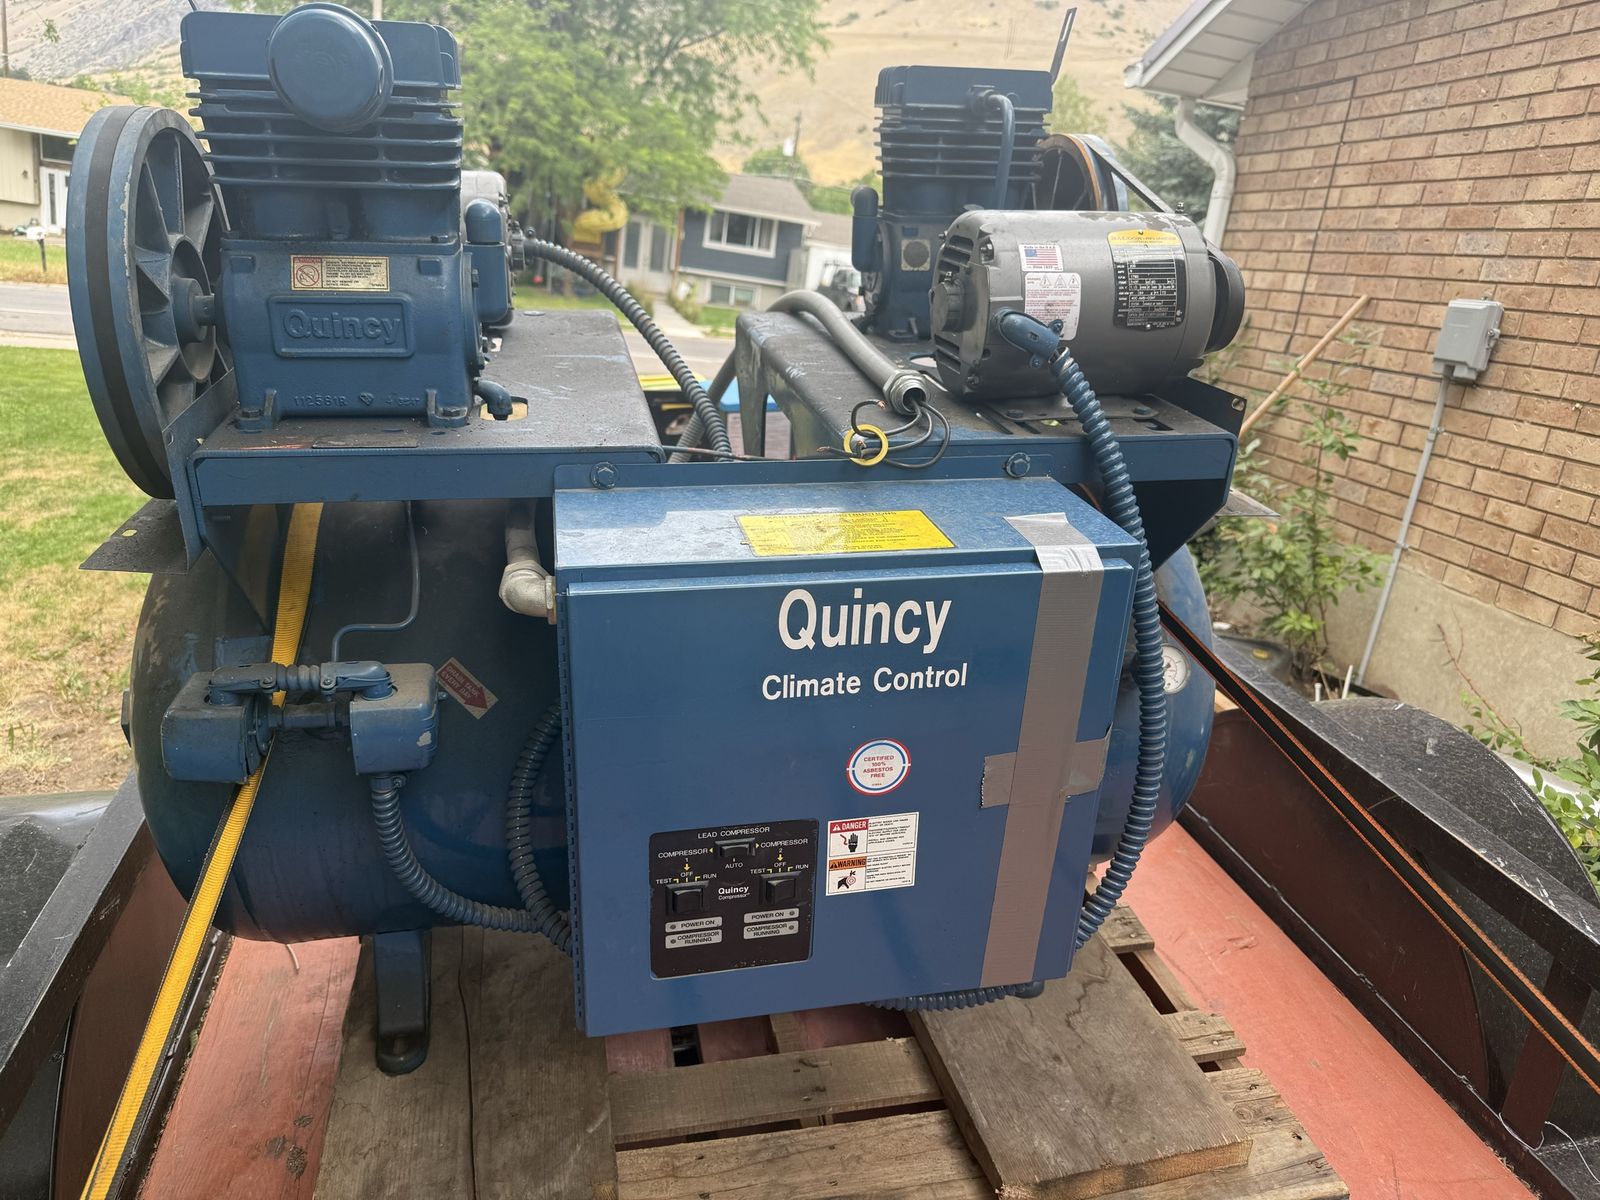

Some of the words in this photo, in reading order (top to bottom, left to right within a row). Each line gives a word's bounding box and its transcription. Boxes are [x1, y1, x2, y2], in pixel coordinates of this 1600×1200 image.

[283, 308, 401, 345] Quincy
[778, 587, 952, 654] Quincy
[762, 672, 861, 700] Climate
[873, 662, 968, 692] Control
[863, 766, 894, 774] ASBESTOS
[842, 821, 867, 830] DANGER
[697, 831, 718, 839] LEAD
[720, 826, 770, 837] COMPRESSOR
[760, 838, 809, 848] COMPRESSOR
[658, 847, 708, 859] COMPRESSOR
[838, 858, 866, 867] WARNING
[718, 886, 750, 895] Quincy
[746, 923, 787, 932] COMPRESSOR
[677, 931, 719, 941] COMPRESSOR
[753, 929, 780, 937] RUNNING
[684, 937, 712, 945] RUNNING
